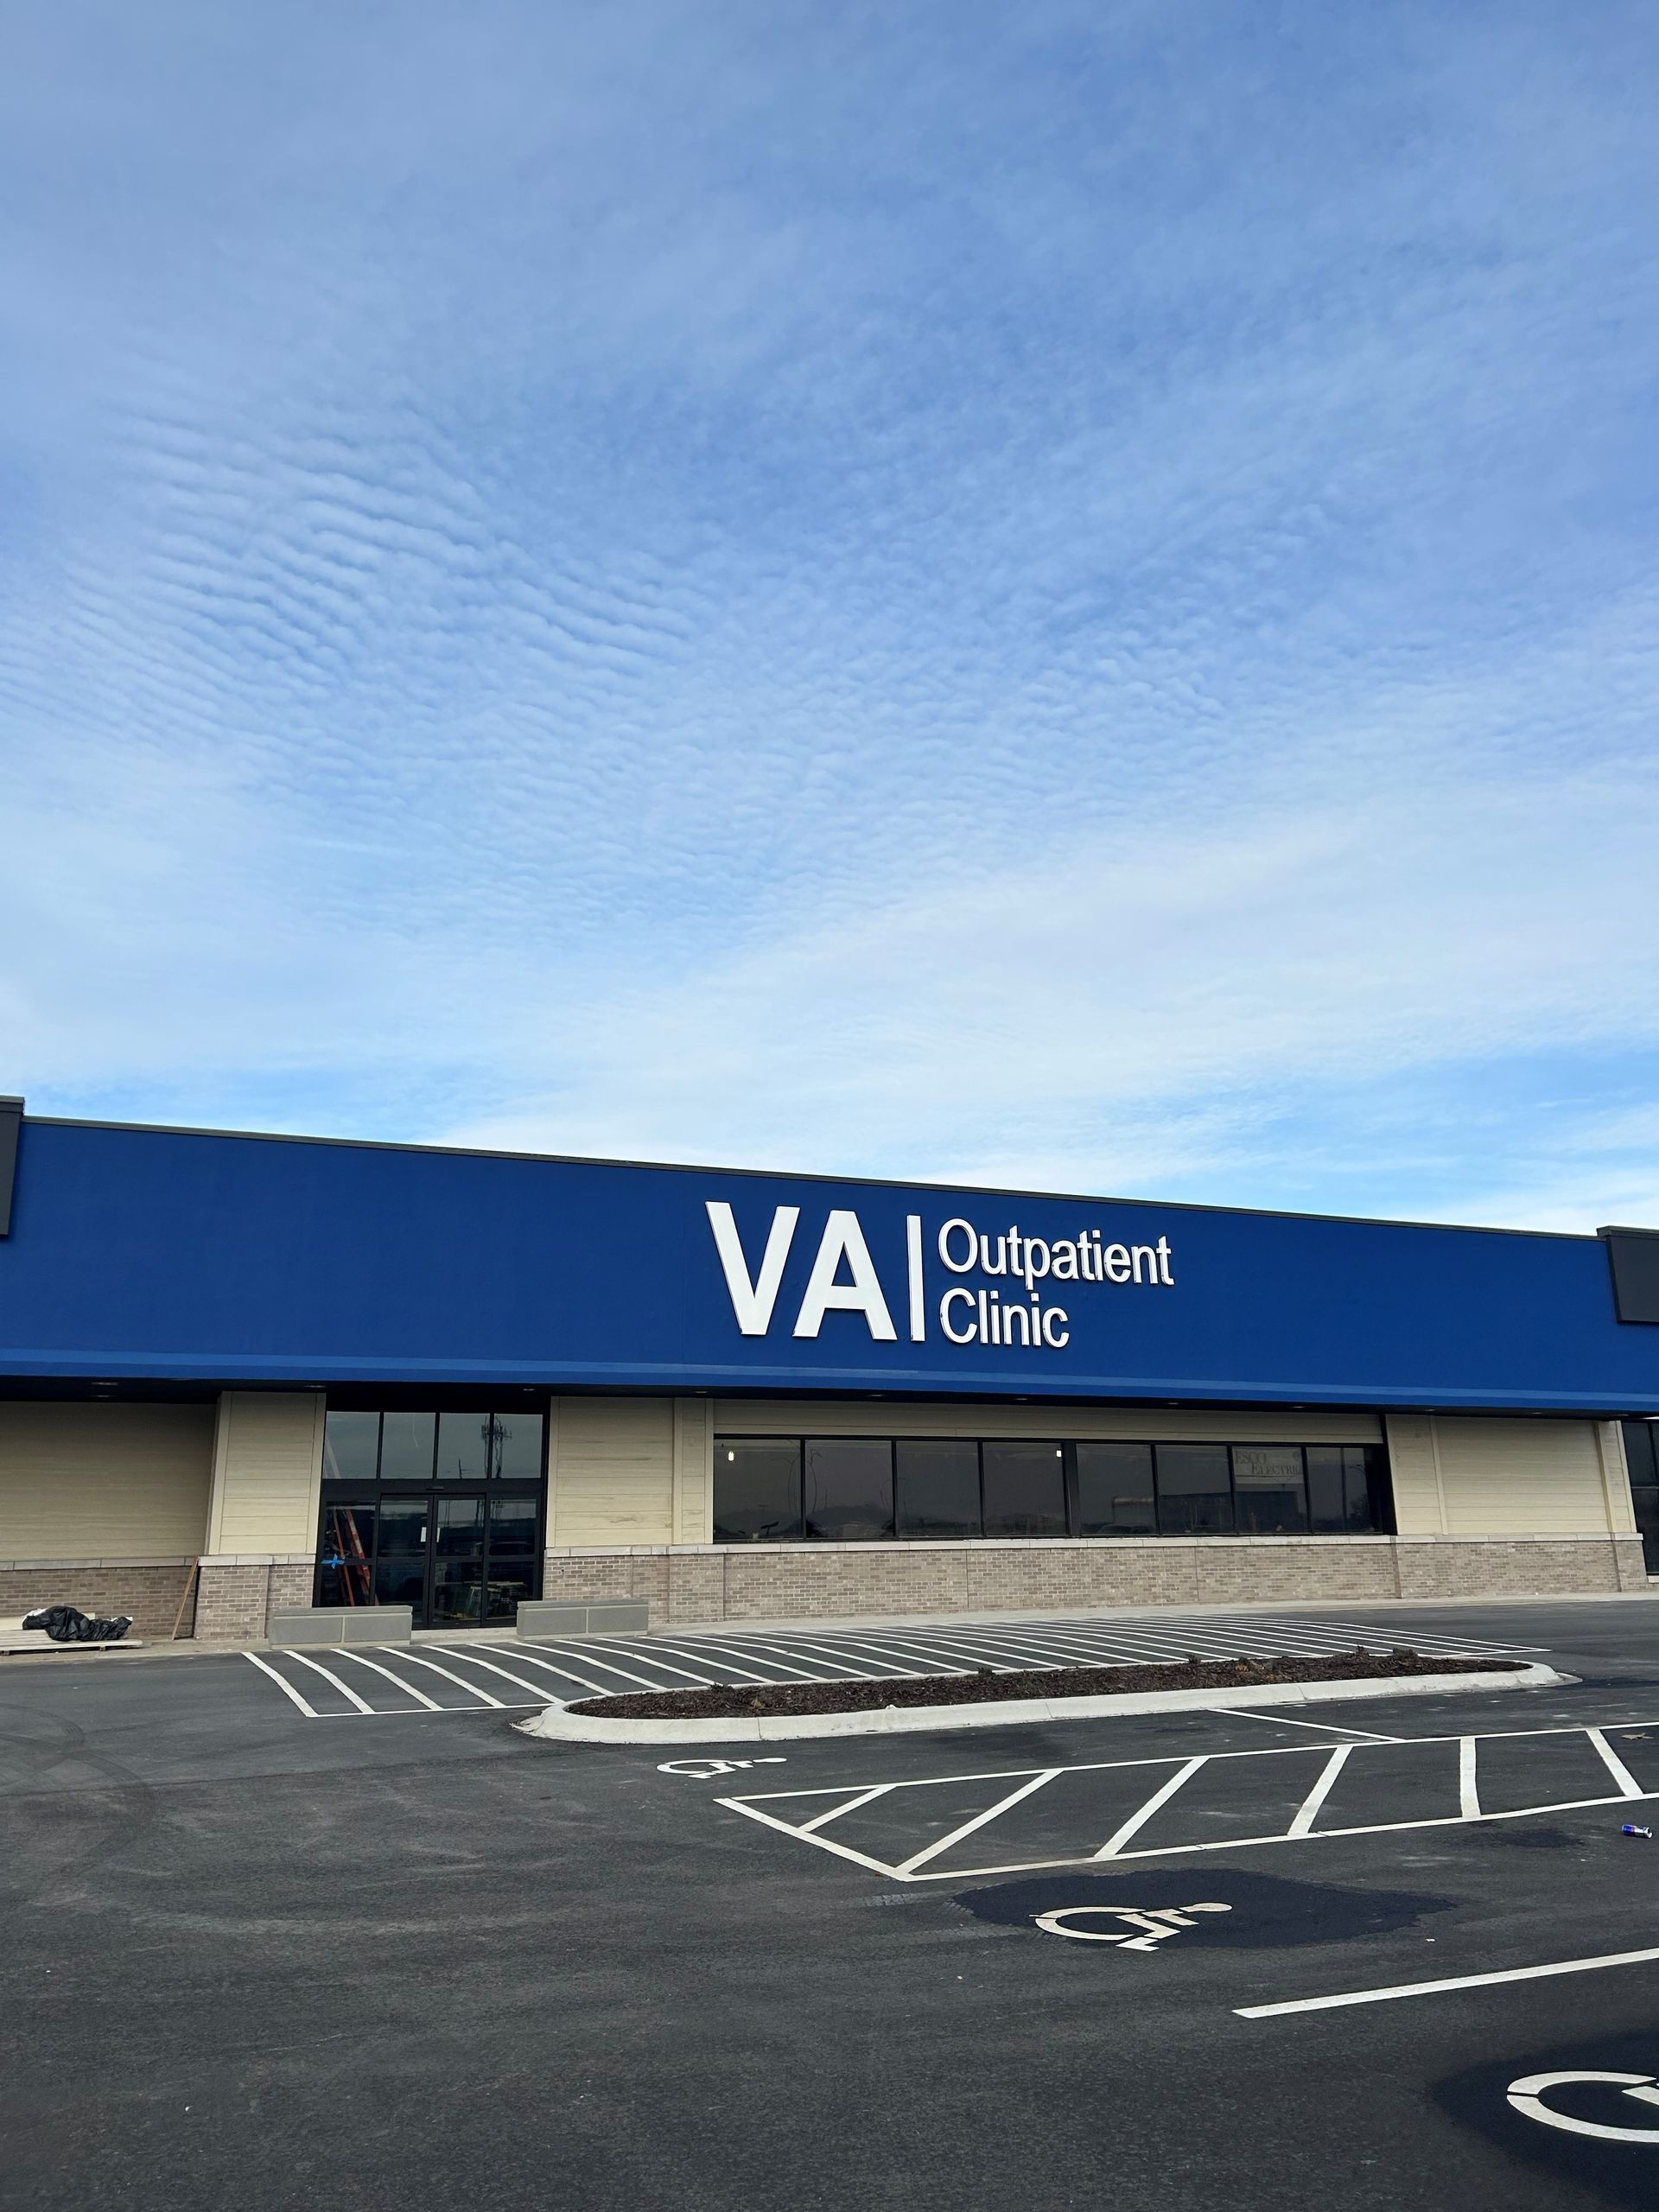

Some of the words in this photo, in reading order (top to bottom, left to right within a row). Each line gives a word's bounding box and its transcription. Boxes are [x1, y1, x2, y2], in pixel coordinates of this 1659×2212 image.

[705, 1202, 898, 1340] VA
[938, 1218, 1175, 1291] Outpatient
[939, 1287, 1071, 1349] Clinic
